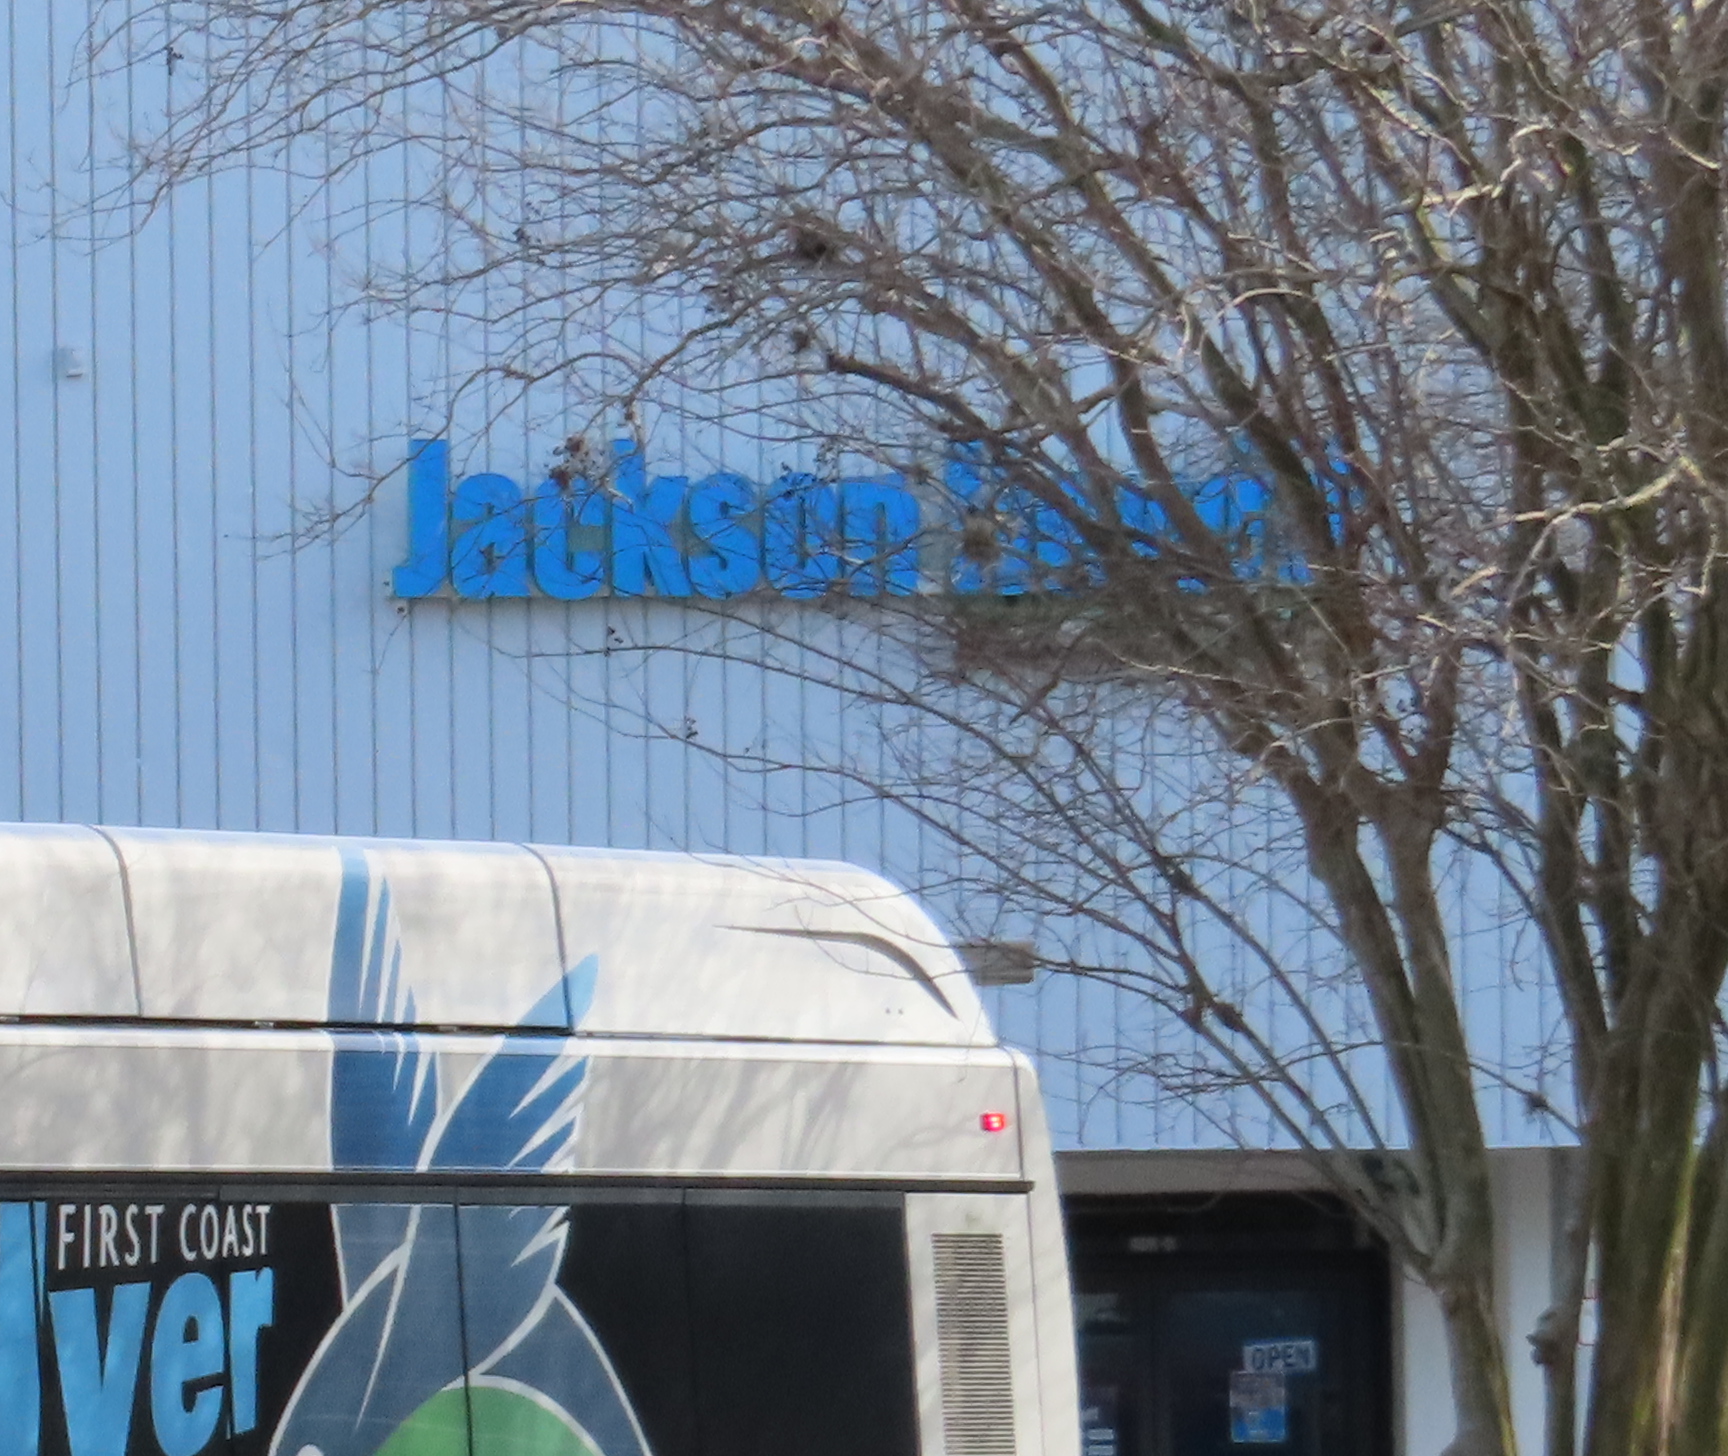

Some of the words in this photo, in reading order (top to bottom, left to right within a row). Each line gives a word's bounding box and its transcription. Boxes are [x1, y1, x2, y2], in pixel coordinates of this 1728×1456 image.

[392, 438, 920, 601] Jackson
[58, 1204, 165, 1270] FIRST
[179, 1204, 272, 1262] COAST
[1250, 1344, 1312, 1371] OPEN
